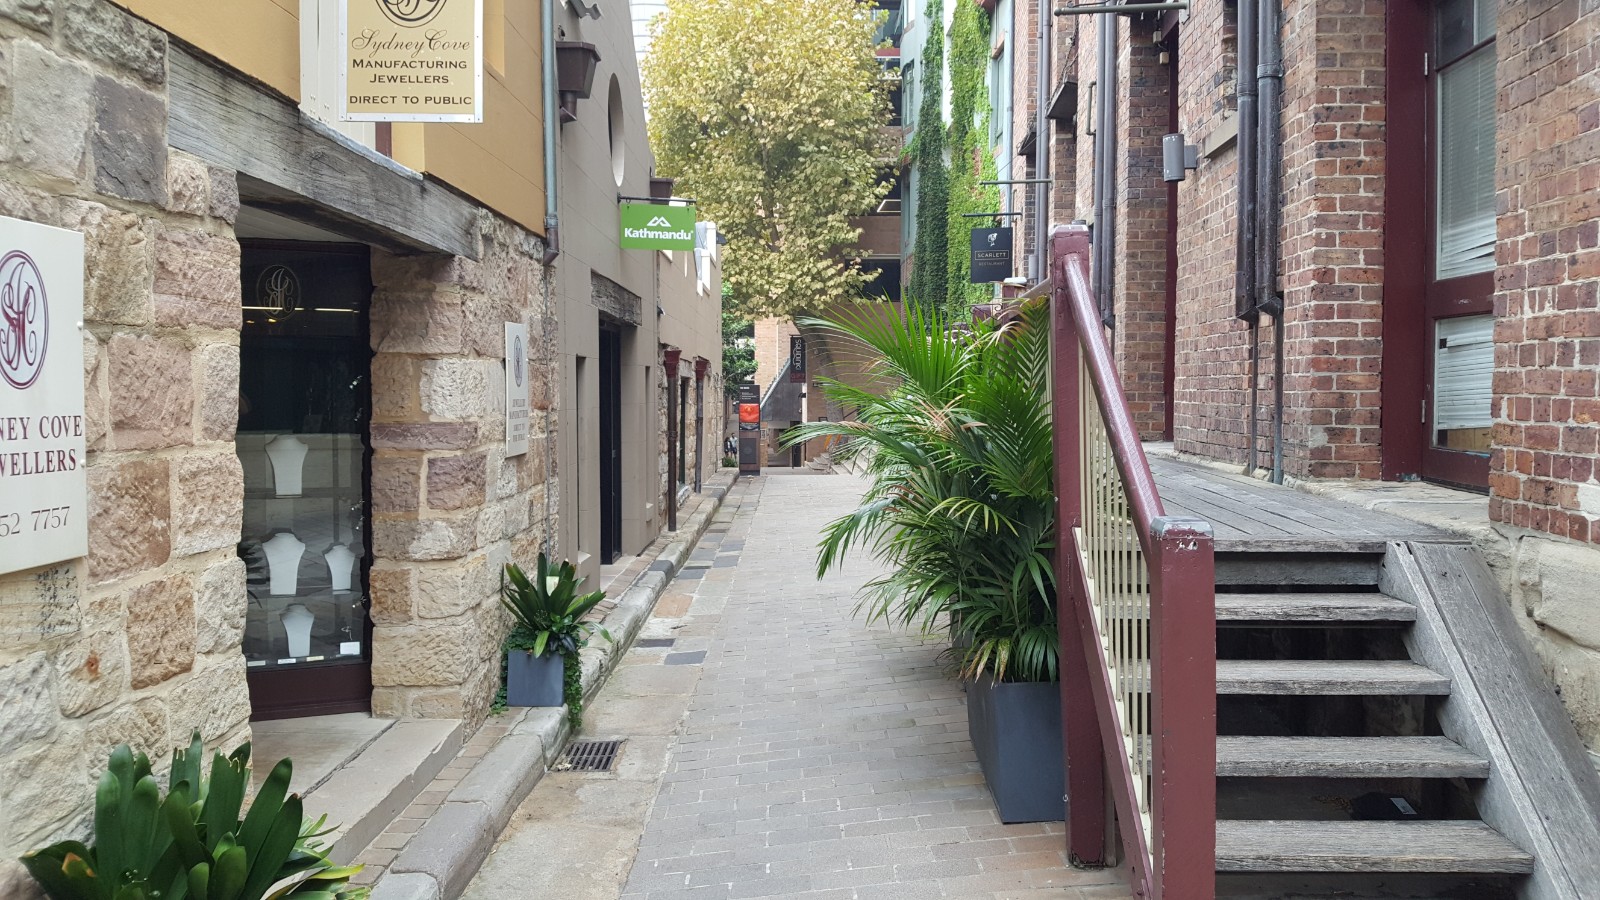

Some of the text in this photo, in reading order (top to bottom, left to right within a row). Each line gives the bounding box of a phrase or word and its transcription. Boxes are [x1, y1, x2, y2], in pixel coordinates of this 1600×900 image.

[351, 28, 471, 59] Sydney Cove
[352, 59, 467, 69] MANUFACTURING
[369, 74, 449, 84] JEWELLERS
[350, 96, 472, 105] DIRECT TO PUBLIC
[624, 227, 692, 240] Kathmandu
[39, 415, 83, 439] COVE
[0, 505, 70, 537] 52 7757
